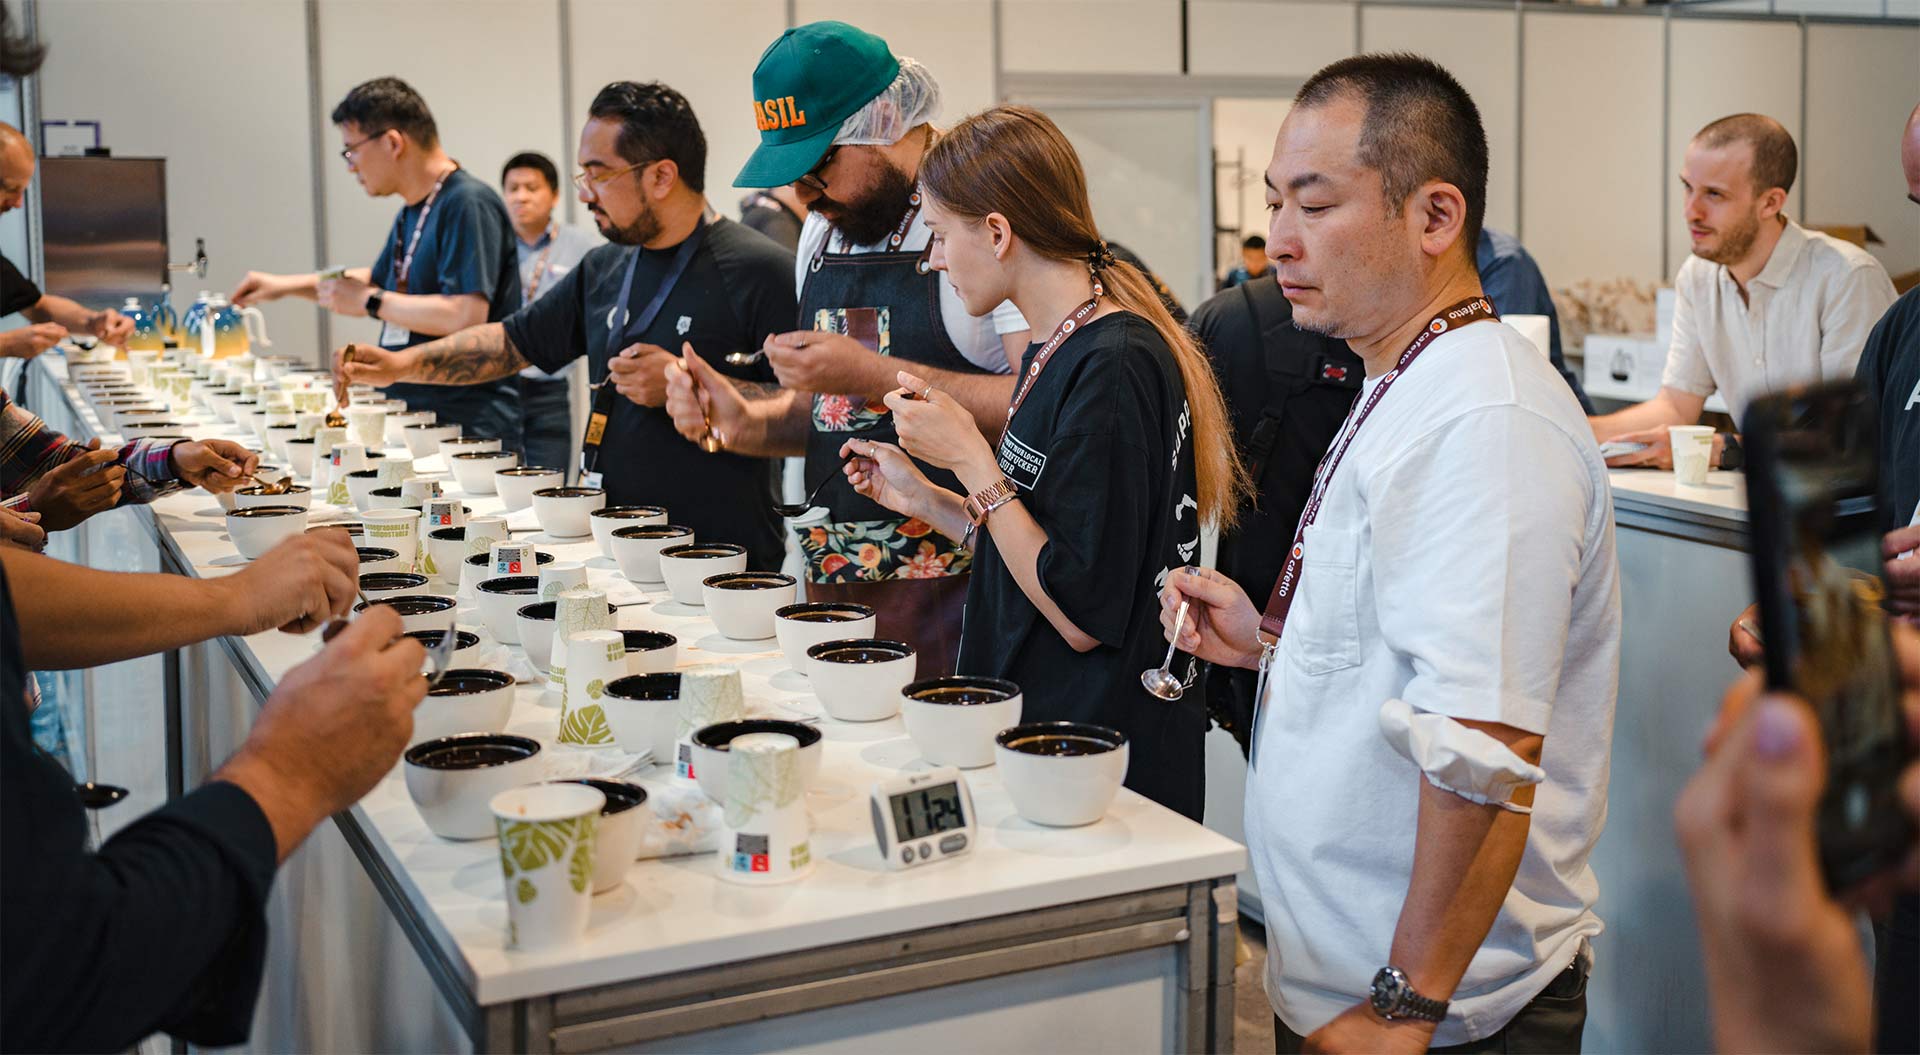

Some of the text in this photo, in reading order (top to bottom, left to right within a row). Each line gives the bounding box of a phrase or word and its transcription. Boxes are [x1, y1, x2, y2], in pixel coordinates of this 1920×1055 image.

[753, 96, 806, 130] ASIL
[1039, 331, 1063, 359] cafetto
[1400, 332, 1430, 365] cafetto
[1023, 451, 1042, 466] LOCAL
[1278, 559, 1296, 597] cafetto
